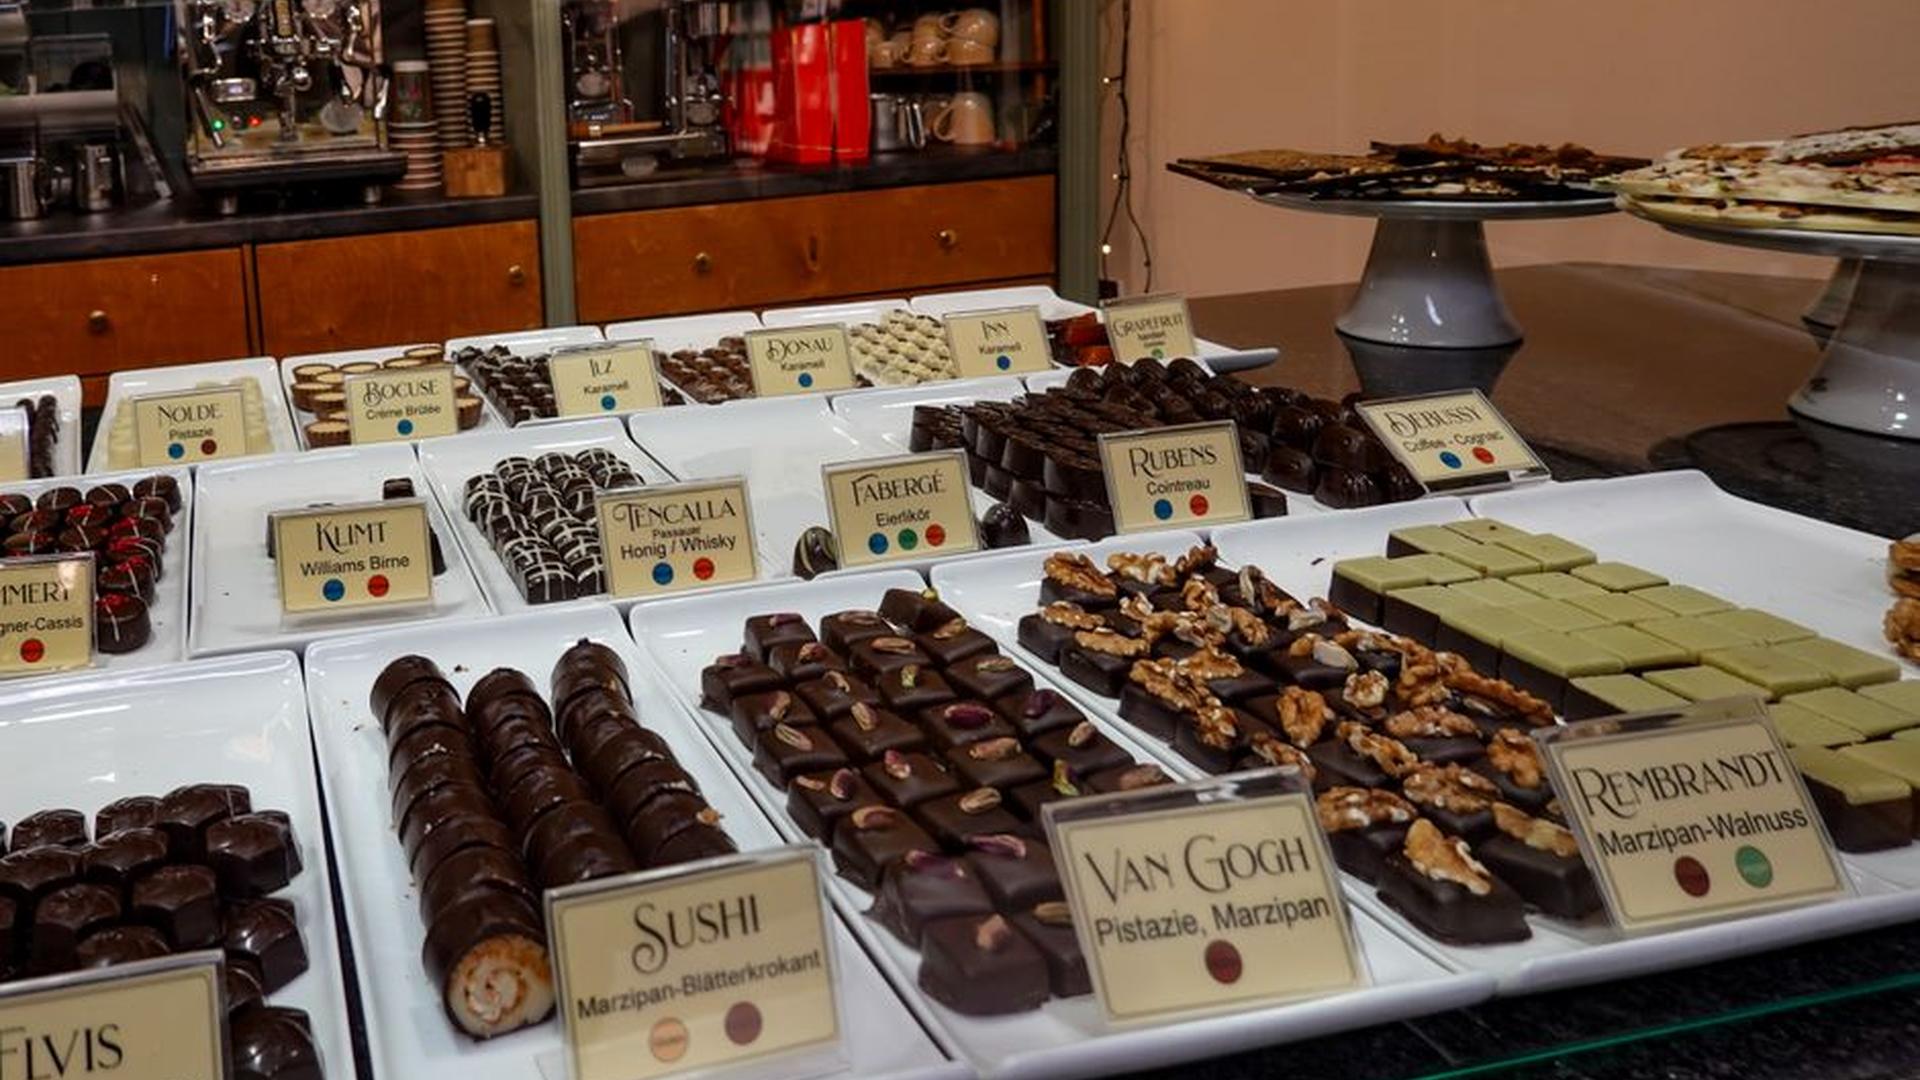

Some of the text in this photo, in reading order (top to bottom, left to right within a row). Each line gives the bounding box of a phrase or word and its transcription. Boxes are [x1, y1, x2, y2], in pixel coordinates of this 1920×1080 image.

[363, 379, 438, 407] BOCUSE
[157, 402, 224, 428] NOLDE
[1384, 406, 1482, 438] DEBUSSY
[1129, 444, 1218, 479] RUBENS
[1146, 479, 1211, 496] Cointreau
[612, 498, 736, 533] TENCALLA
[875, 508, 931, 527] Eierlikör
[315, 521, 387, 555] KLIMT
[621, 541, 667, 559] Honig
[679, 533, 735, 552] Whisky
[300, 555, 410, 577] Williams Birne
[1571, 750, 1783, 820] REMBRANDT
[1597, 807, 1809, 857] Marzipan-Walnuss
[1084, 834, 1311, 905] VAN GOGH
[631, 893, 760, 976] SUSHI
[1095, 896, 1331, 946] Pistazie, Marzipan
[577, 949, 822, 1019] Marzipan-Blätterkrokant
